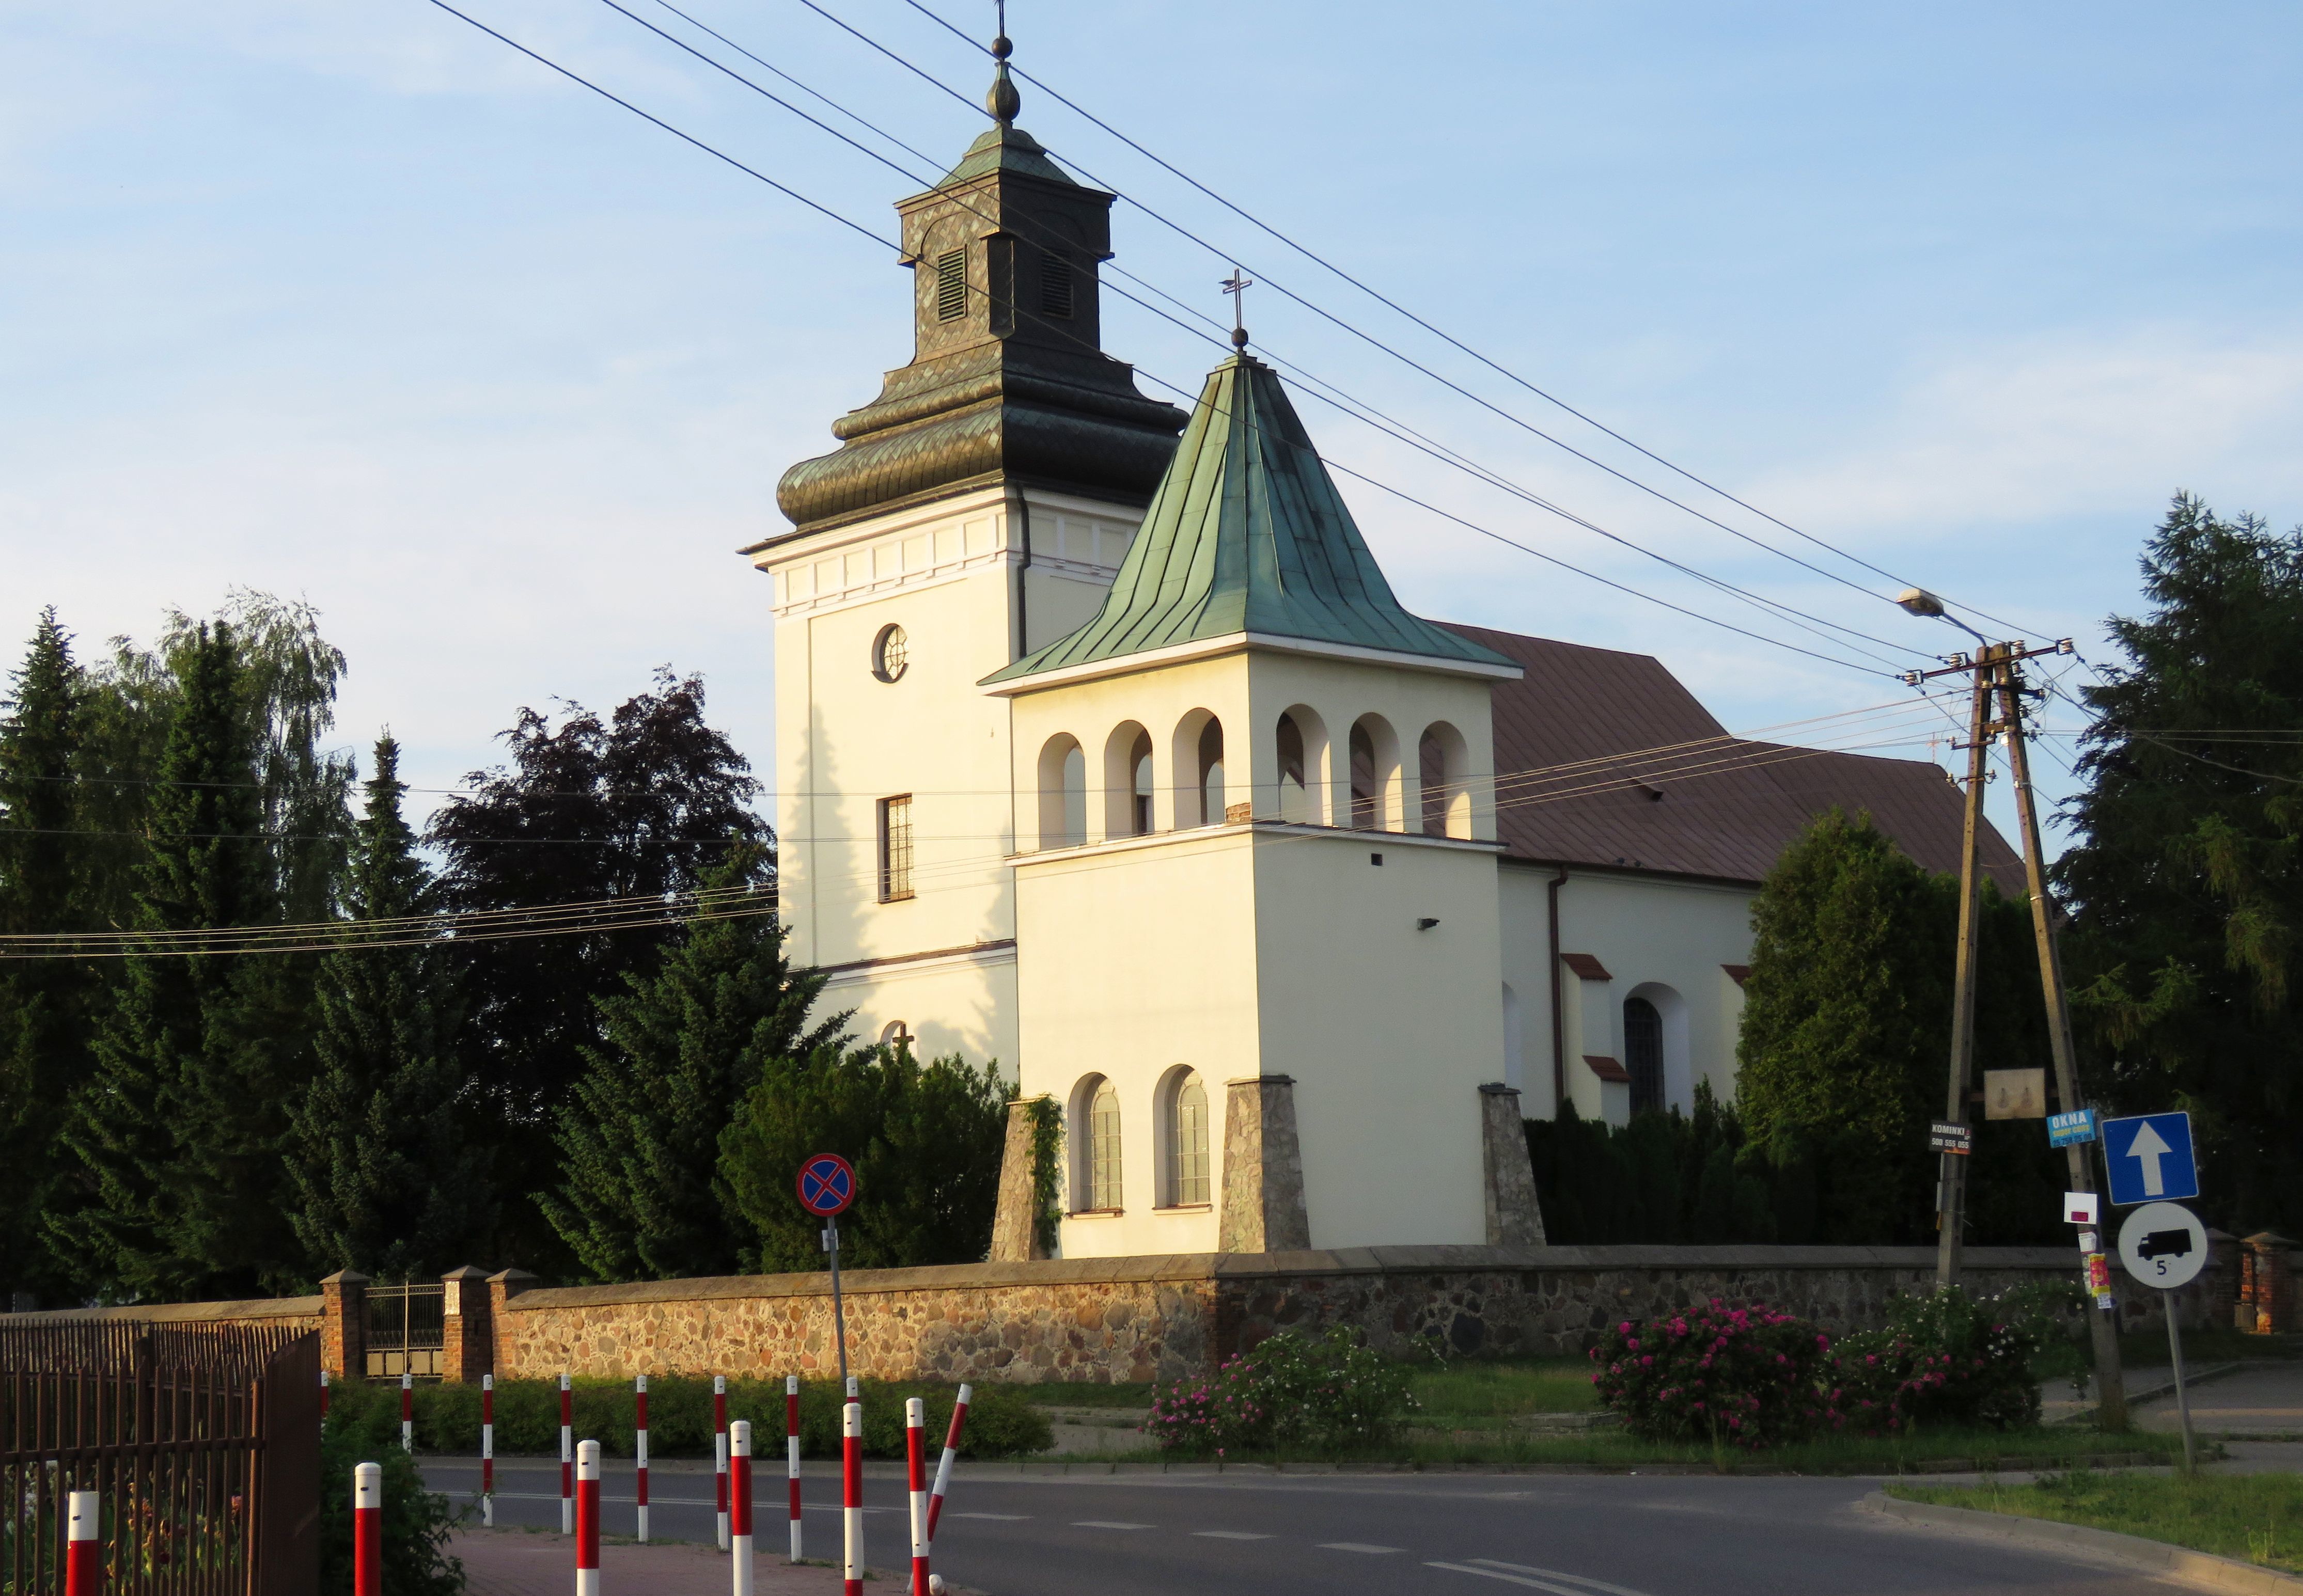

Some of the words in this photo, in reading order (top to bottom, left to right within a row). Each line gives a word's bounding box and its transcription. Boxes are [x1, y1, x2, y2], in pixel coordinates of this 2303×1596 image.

[2053, 1112, 2087, 1128] OKNA
[1932, 1125, 1965, 1135] KOMINKI
[2157, 1260, 2167, 1275] 5
